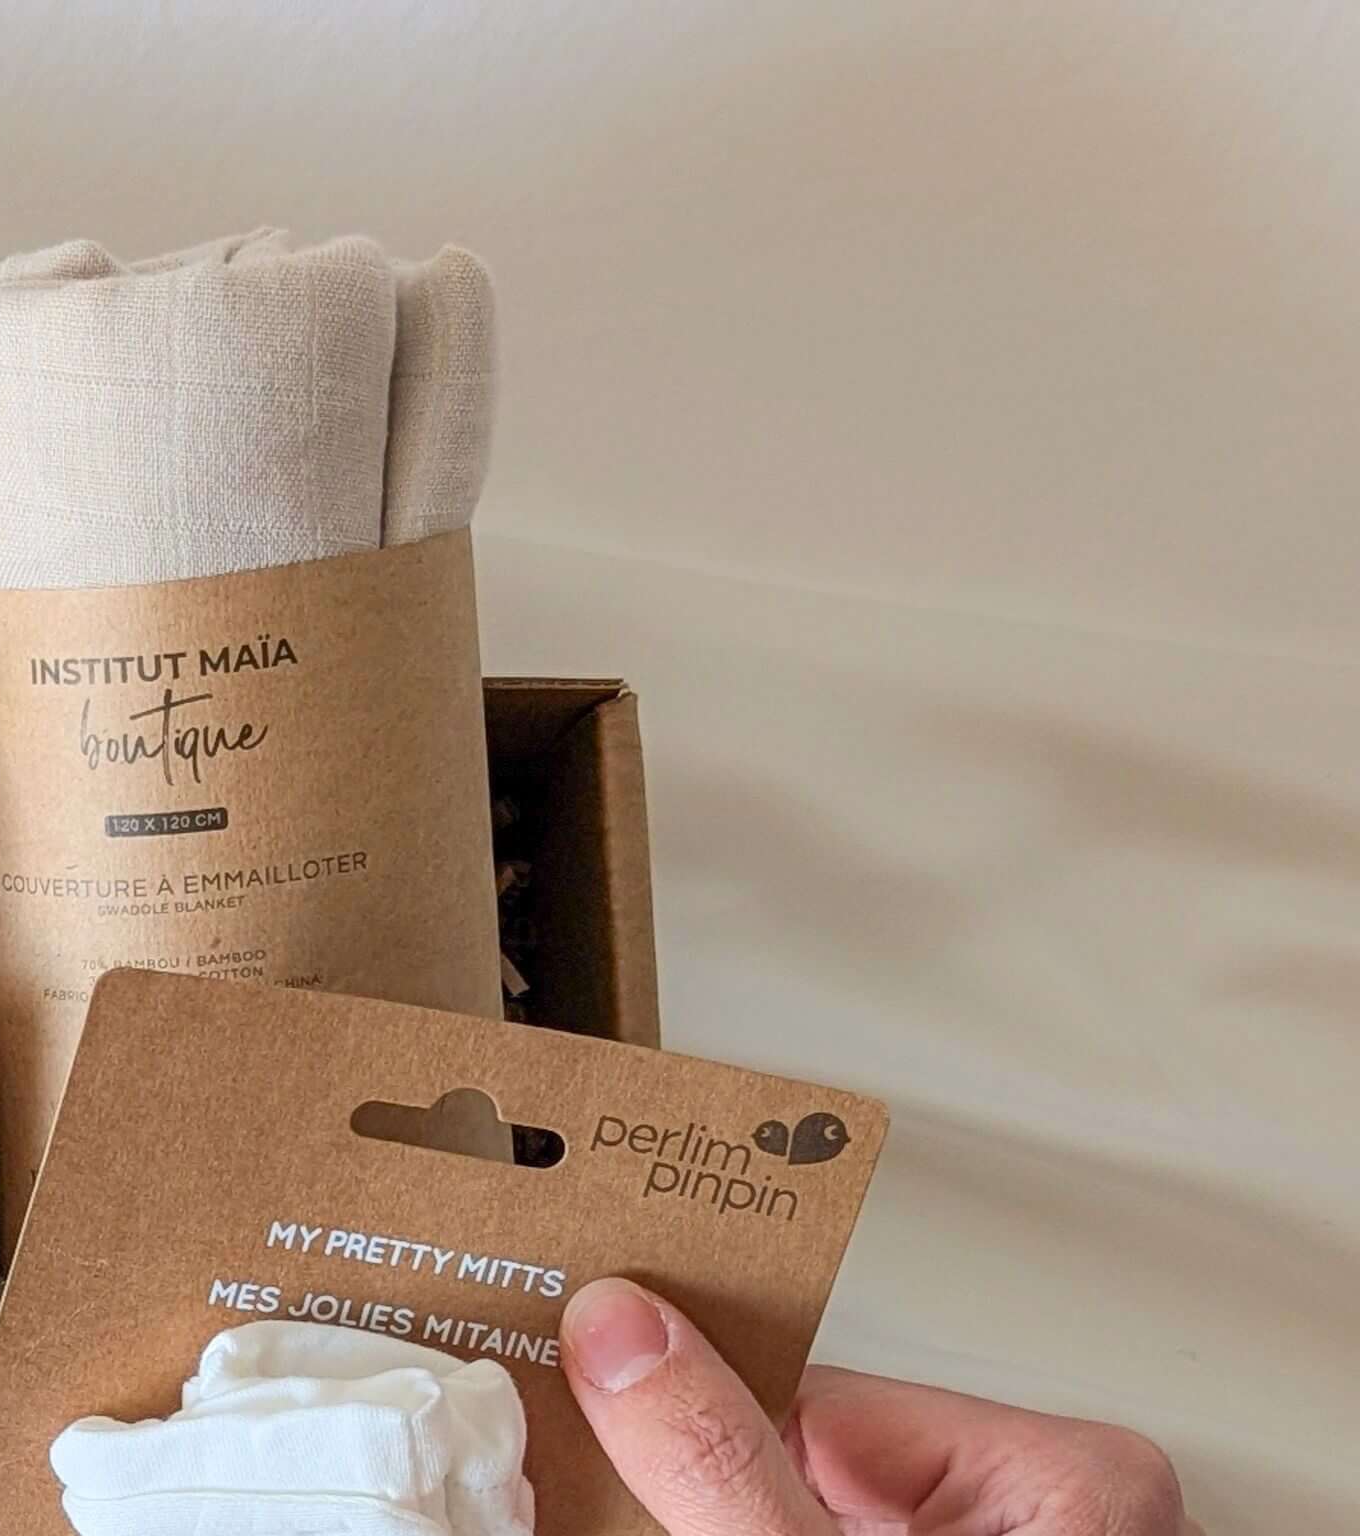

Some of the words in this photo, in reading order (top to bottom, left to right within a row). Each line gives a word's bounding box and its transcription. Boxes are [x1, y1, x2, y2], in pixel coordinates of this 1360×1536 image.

[30, 652, 186, 685] INSTITUT
[198, 634, 298, 677] MAÏA
[79, 688, 268, 786] boutique
[112, 818, 140, 833] 120
[161, 815, 191, 831] 120
[195, 812, 221, 827] CM
[1, 872, 147, 898] COUVERTURE
[156, 875, 175, 897] À
[184, 851, 369, 894] EMMAILLOTER
[175, 895, 246, 914] BLANKET
[196, 949, 267, 967] BAMBOO
[590, 1112, 753, 1174] perlim
[642, 1160, 800, 1223] pinpin
[266, 1220, 324, 1258] MY
[323, 1226, 455, 1279] PRETTY
[455, 1254, 566, 1298] MITTS
[207, 1279, 281, 1315] MES
[287, 1291, 416, 1337] JOLIES
